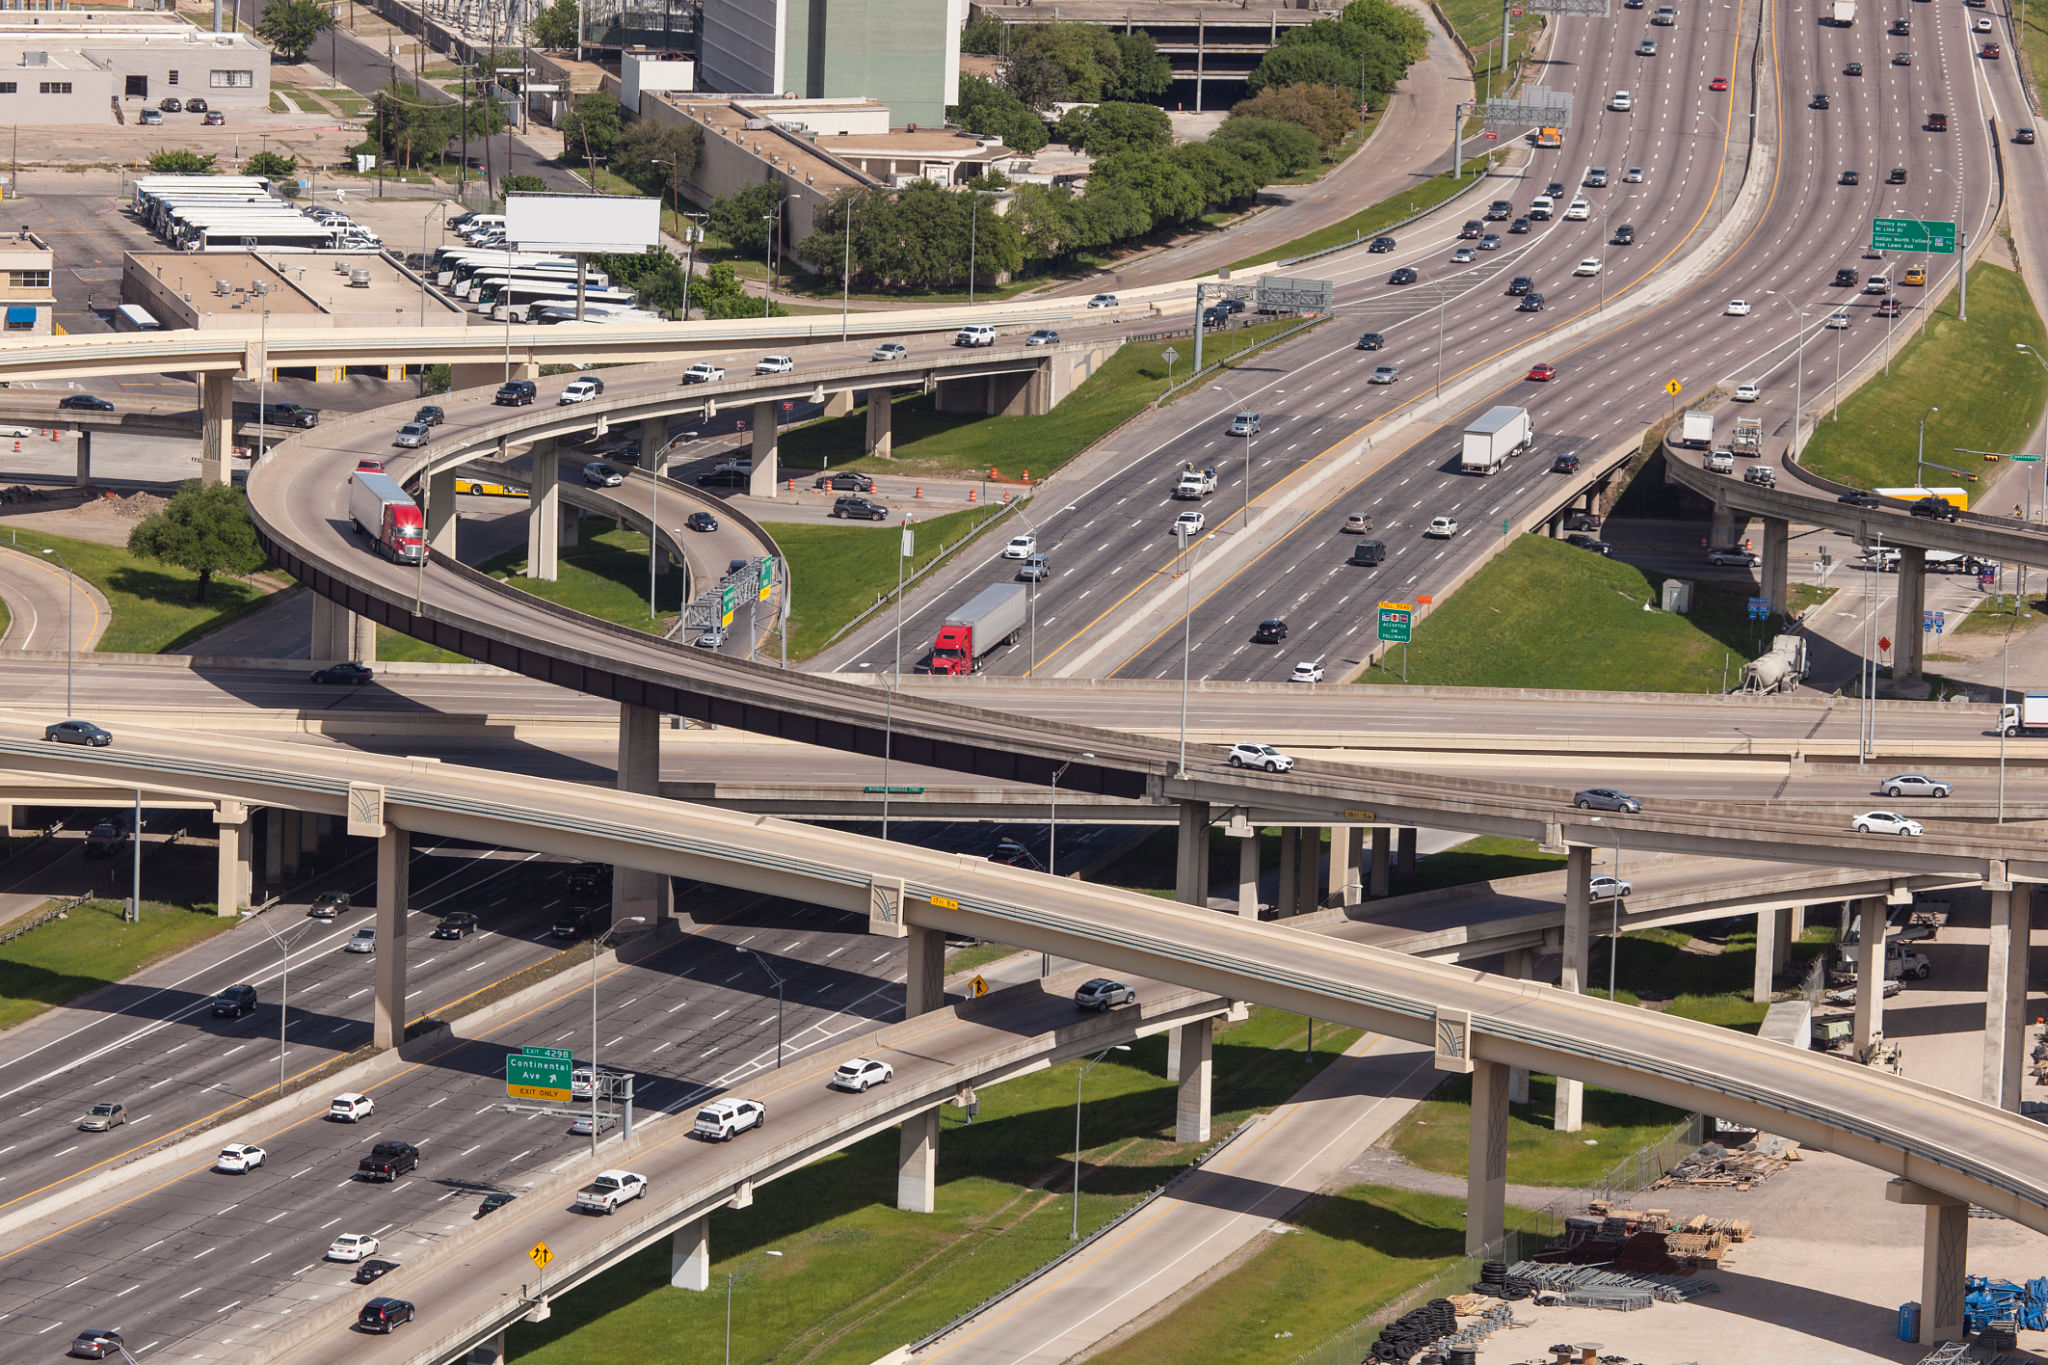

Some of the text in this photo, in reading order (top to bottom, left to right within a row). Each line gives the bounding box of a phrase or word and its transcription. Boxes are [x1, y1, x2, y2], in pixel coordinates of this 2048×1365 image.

[544, 1048, 569, 1059] 429B
[510, 1059, 569, 1071] Continental
[522, 1071, 540, 1080] Ave
[520, 1088, 558, 1097] EXIT ONLY
